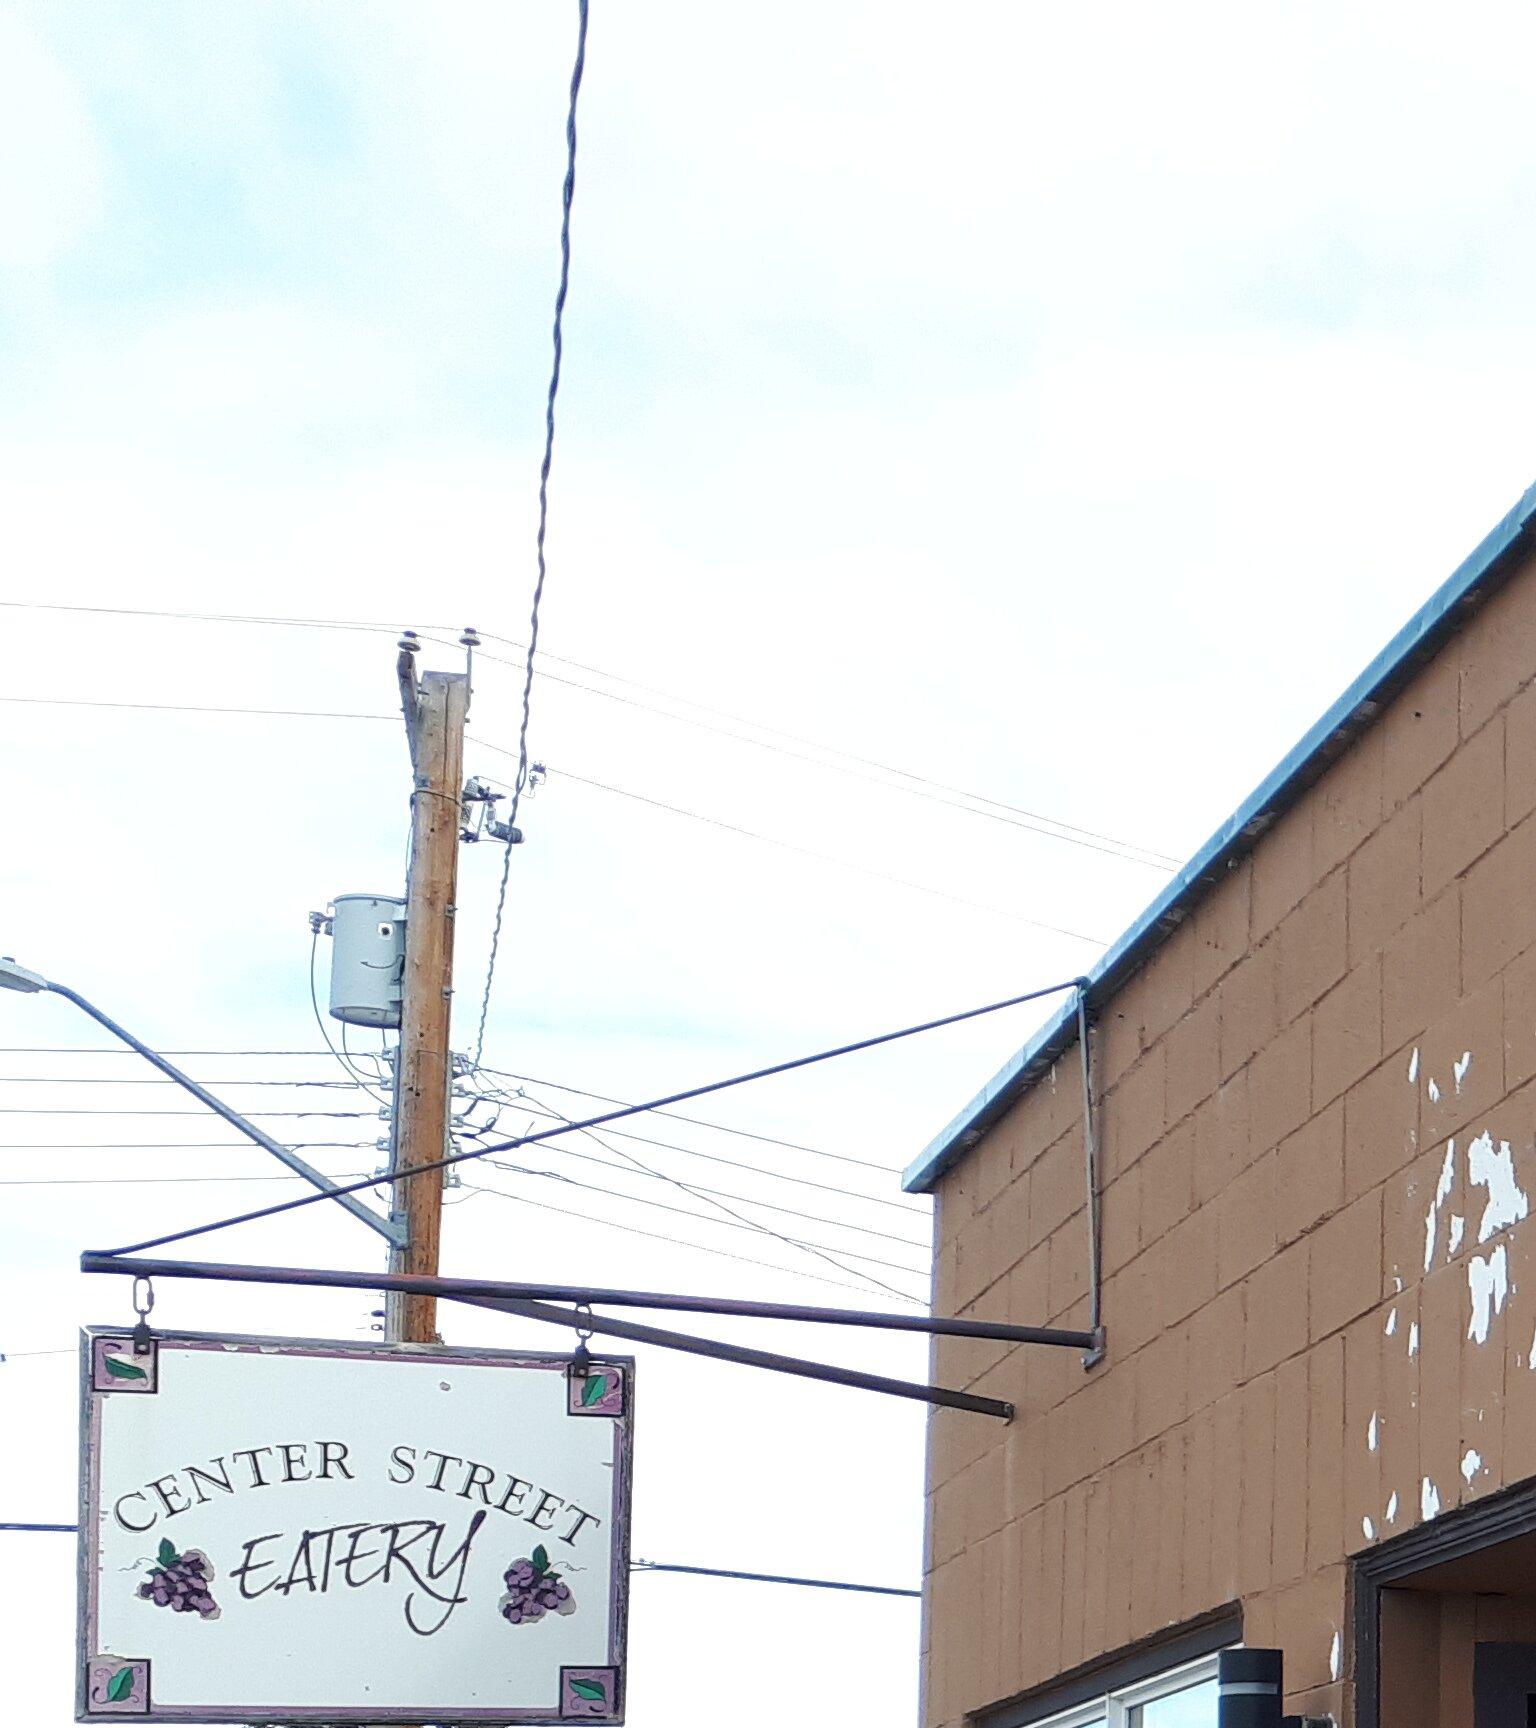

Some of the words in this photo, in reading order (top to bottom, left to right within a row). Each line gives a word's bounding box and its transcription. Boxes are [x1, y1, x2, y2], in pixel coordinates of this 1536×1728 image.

[114, 1441, 354, 1532] CENTER
[389, 1446, 600, 1547] STREET
[229, 1509, 487, 1636] EATERY
